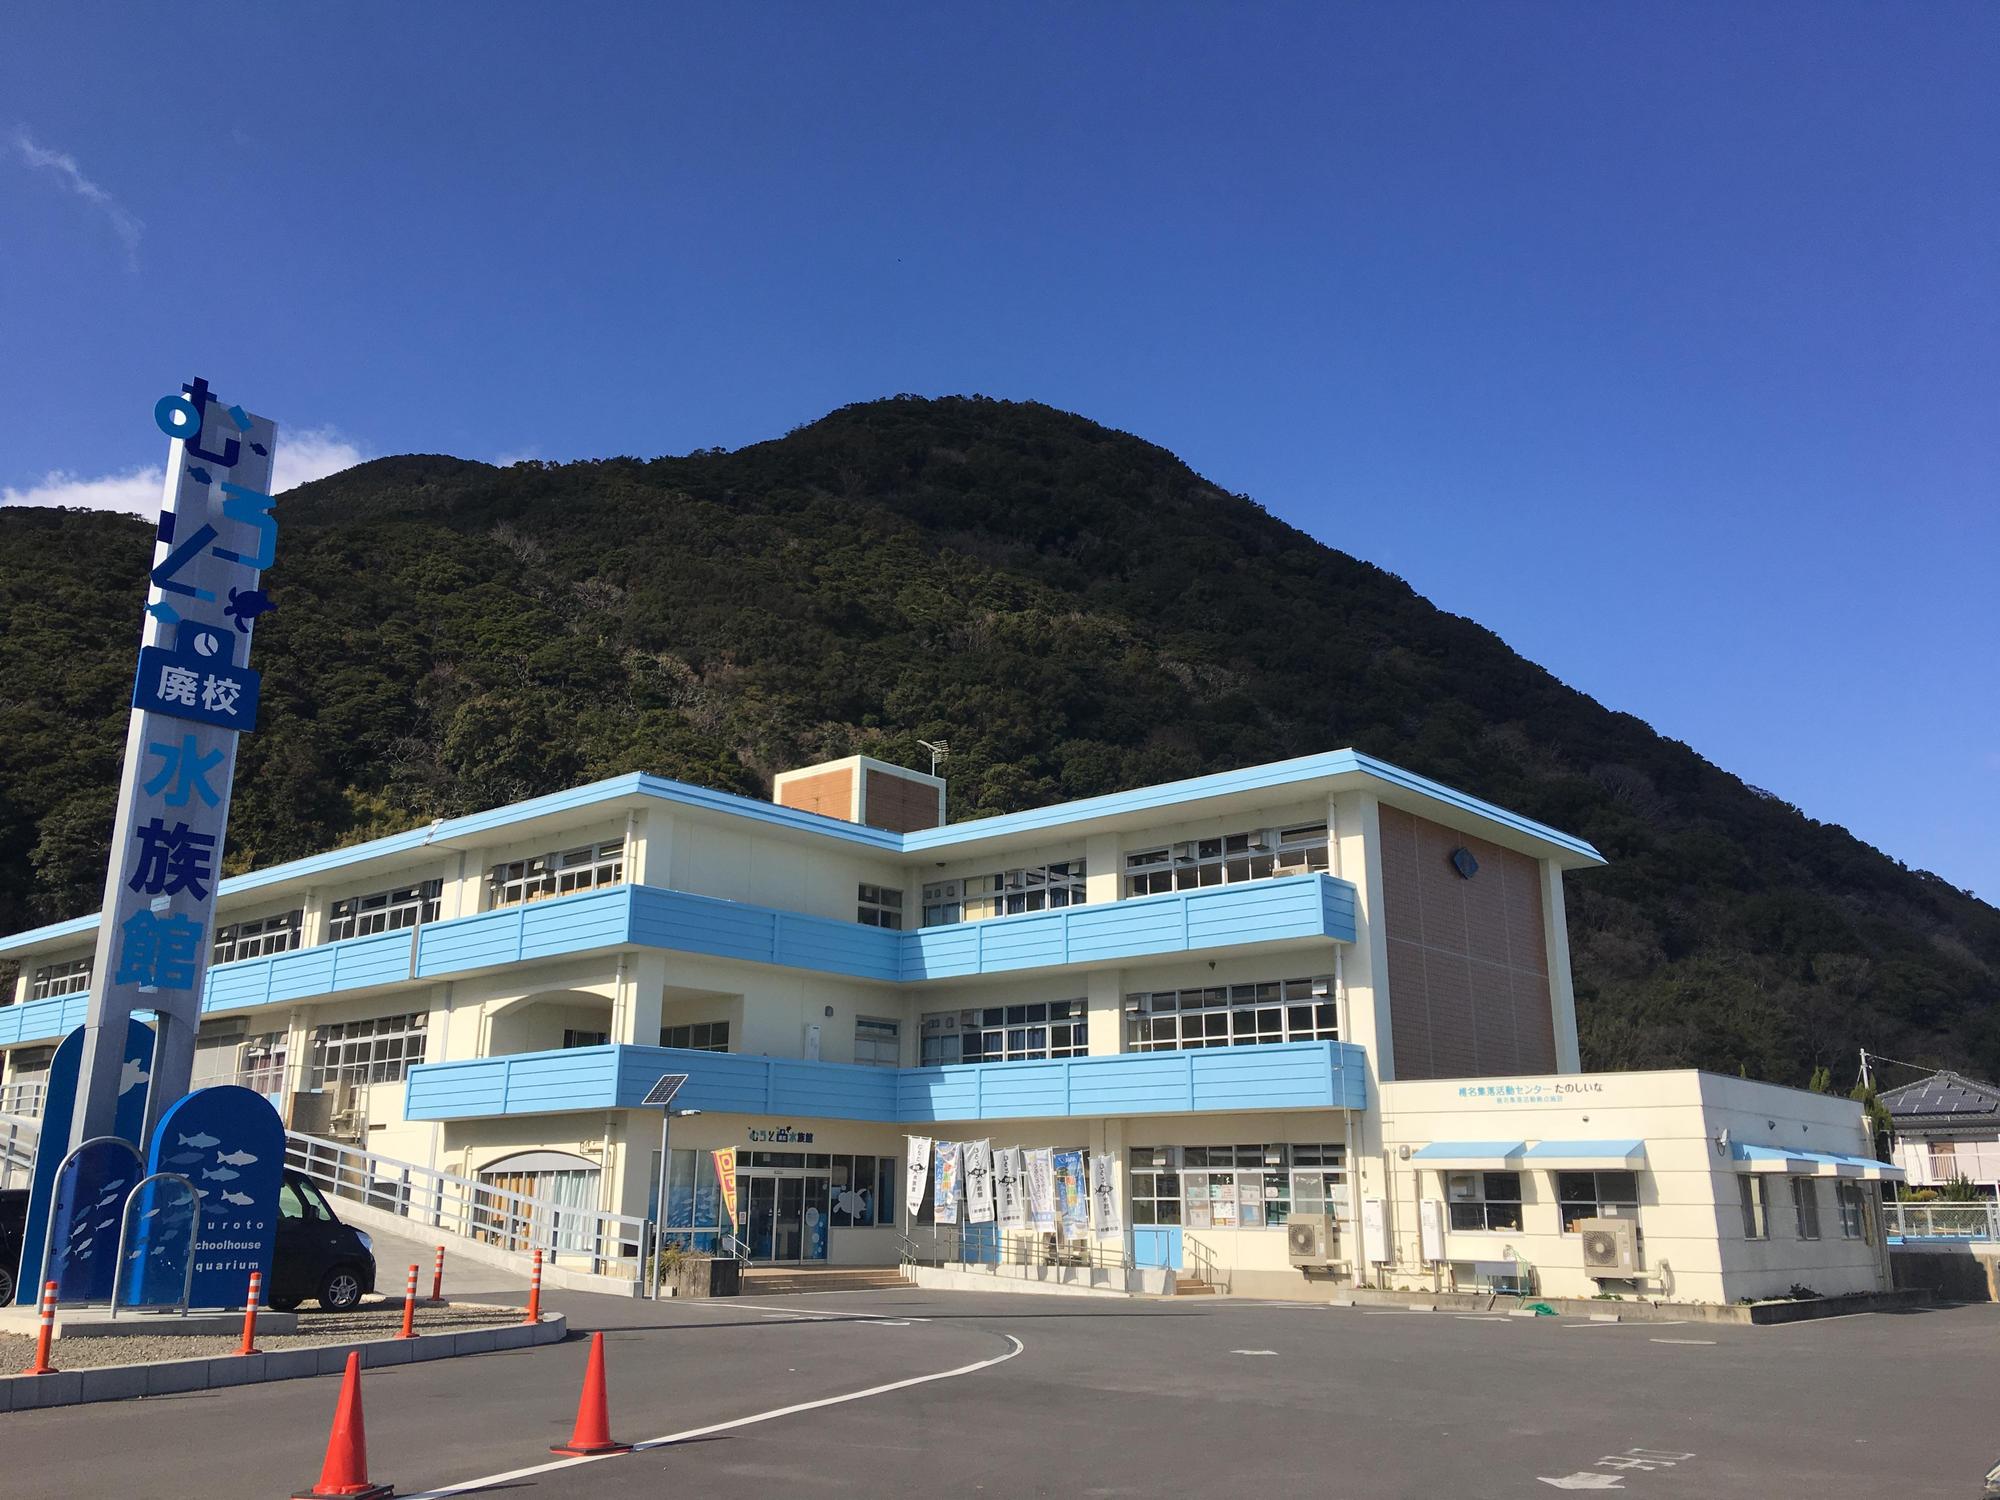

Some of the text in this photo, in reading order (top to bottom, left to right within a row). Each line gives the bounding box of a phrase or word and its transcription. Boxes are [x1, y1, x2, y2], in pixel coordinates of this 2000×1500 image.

[156, 664, 242, 716] 廃校
[115, 734, 225, 990] 水族館
[1555, 1082, 1603, 1094] たのしいな
